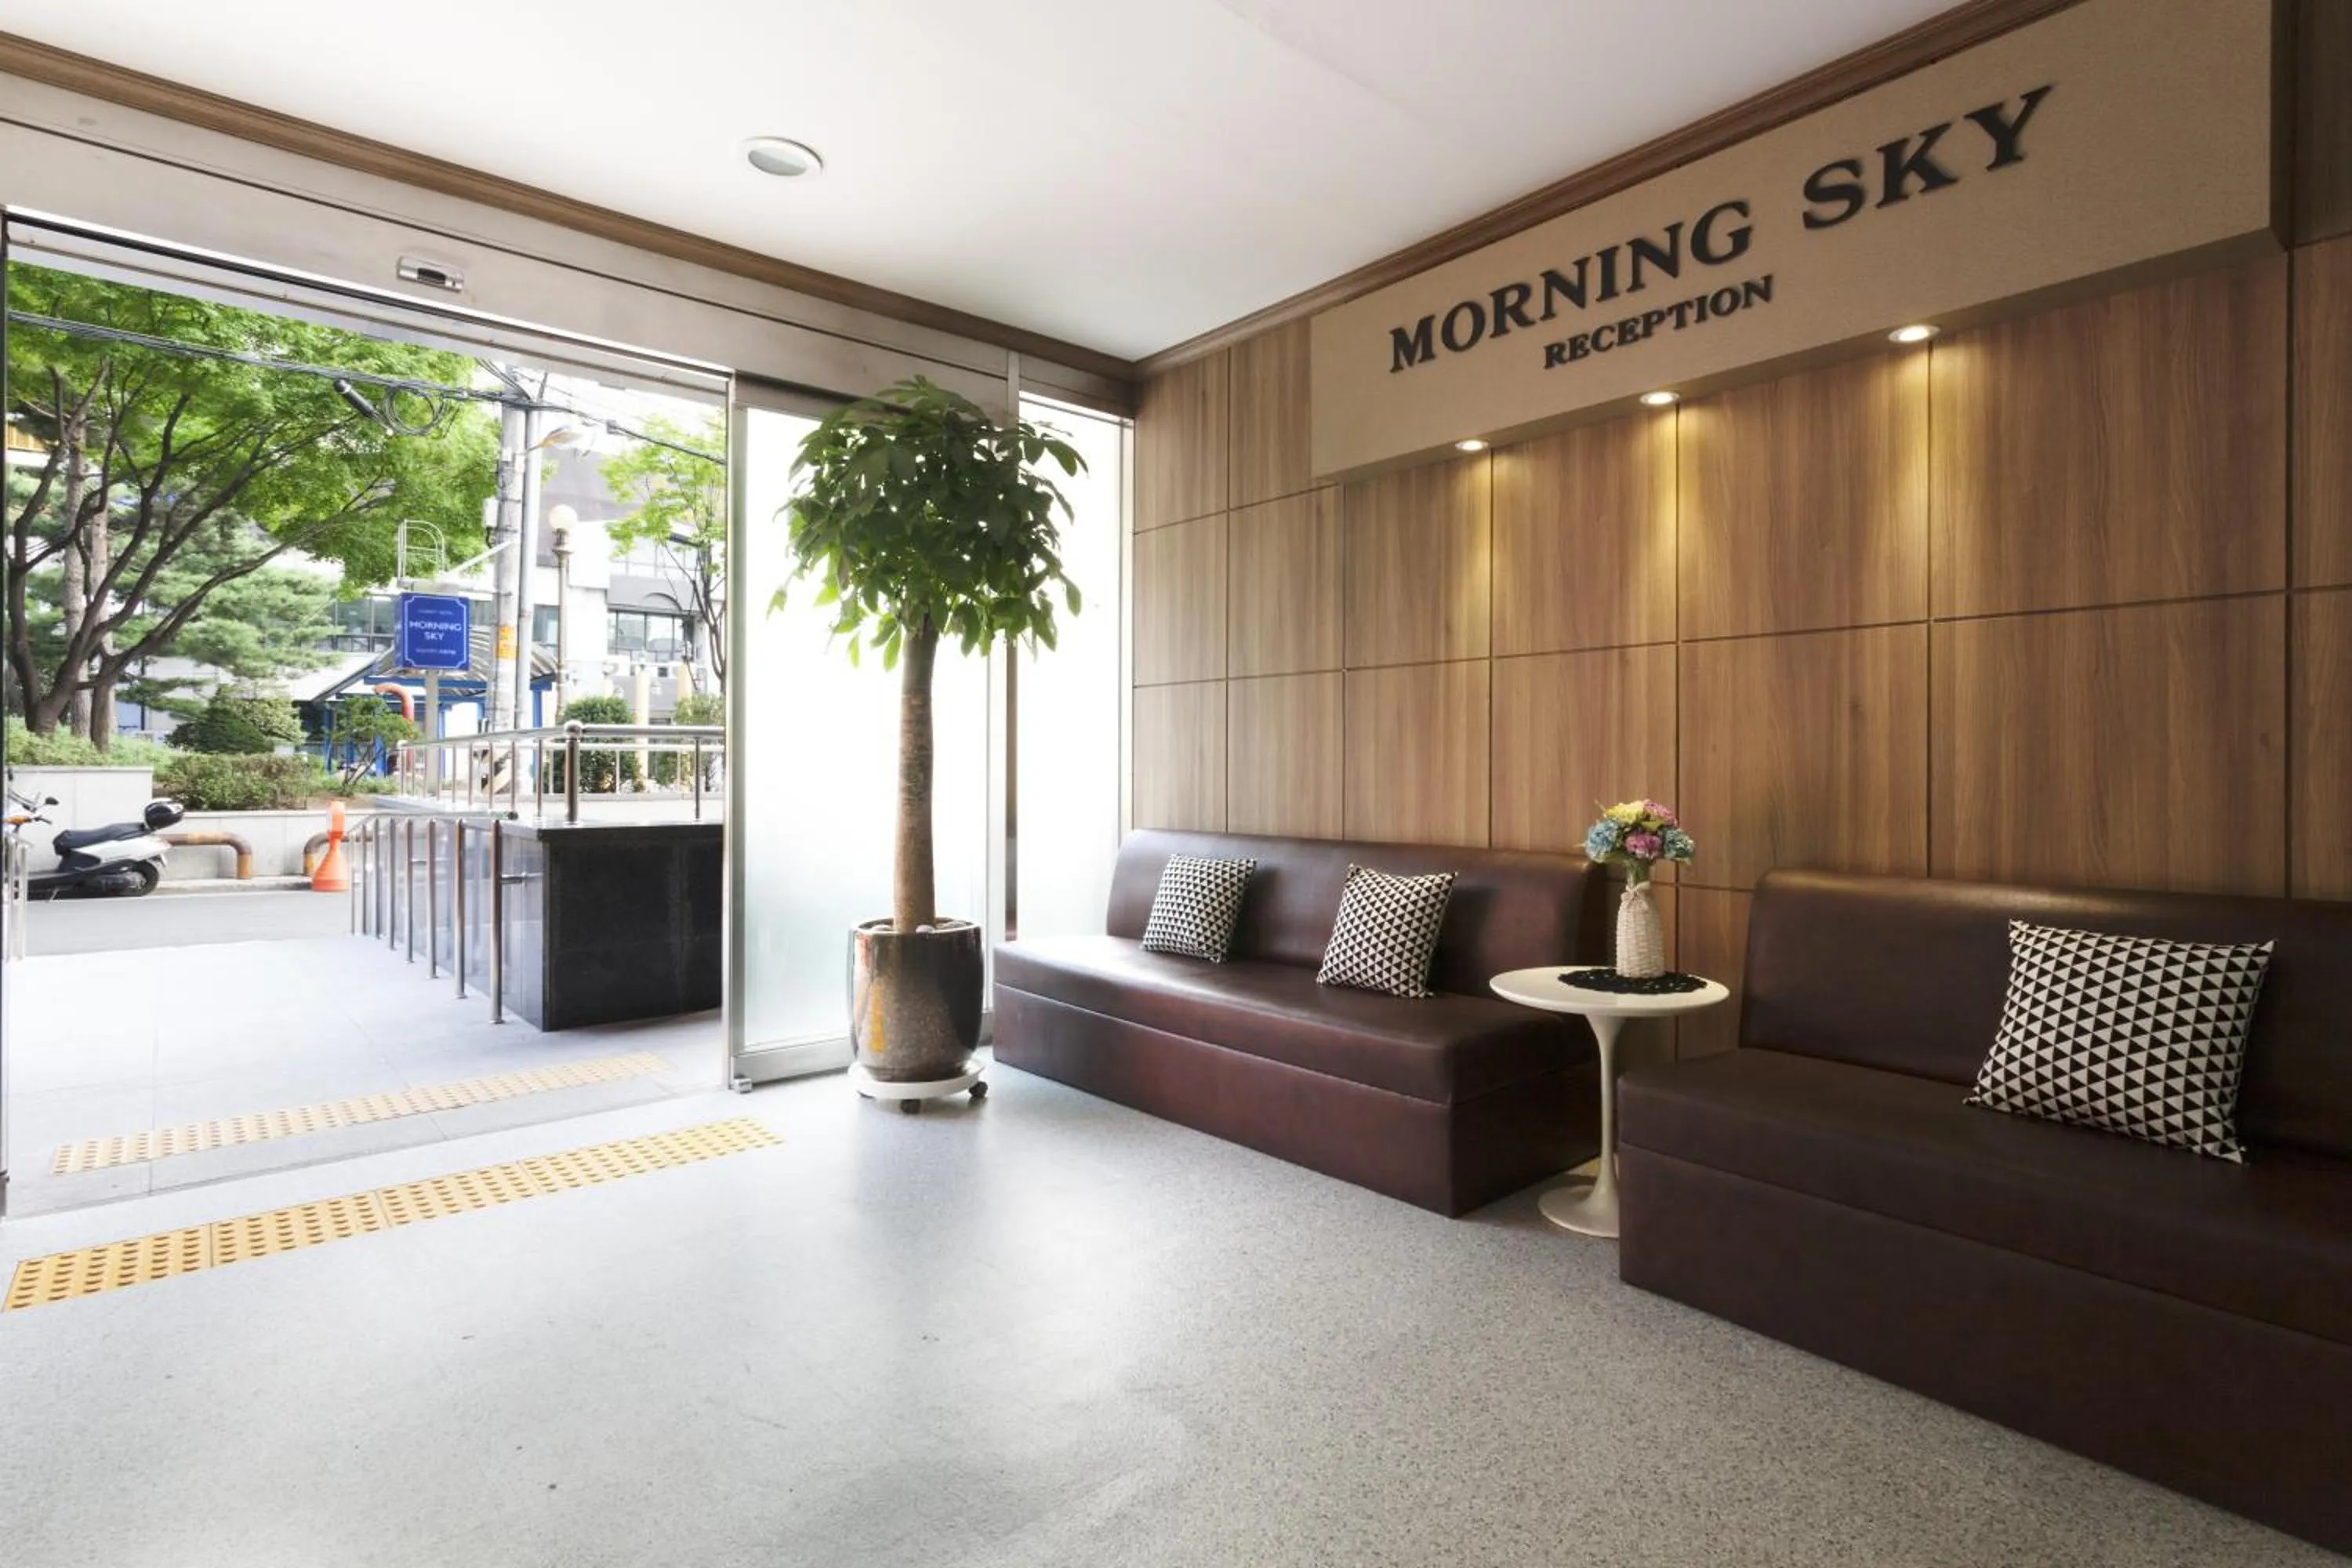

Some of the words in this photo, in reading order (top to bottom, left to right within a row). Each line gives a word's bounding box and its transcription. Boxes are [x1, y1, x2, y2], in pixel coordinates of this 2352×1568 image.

[1388, 199, 1755, 373] MORNING
[1802, 84, 2056, 230] SKY
[1543, 274, 1774, 369] RECEPTION
[408, 620, 463, 632] MORNING
[423, 631, 445, 641] SKY
